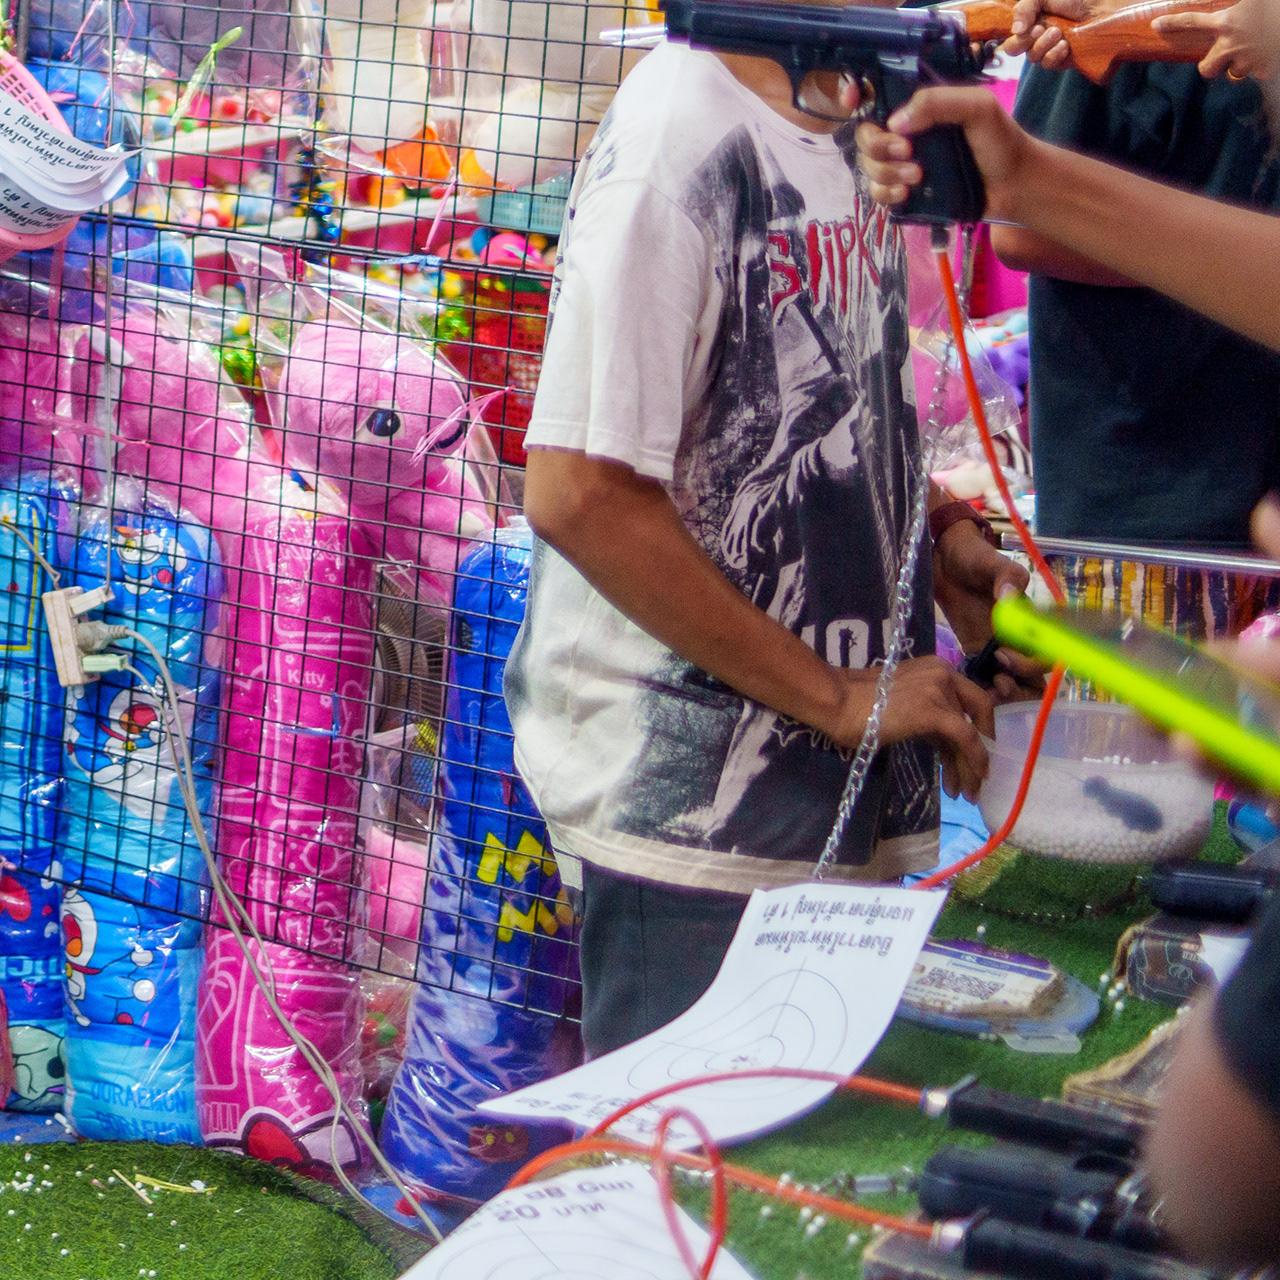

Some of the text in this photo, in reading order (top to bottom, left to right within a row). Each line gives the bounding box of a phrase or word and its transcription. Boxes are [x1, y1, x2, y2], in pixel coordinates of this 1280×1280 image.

[2, 188, 21, 202] ตัว
[288, 669, 327, 688] Ktty
[780, 902, 790, 919] 1
[576, 1179, 635, 1195] Gun
